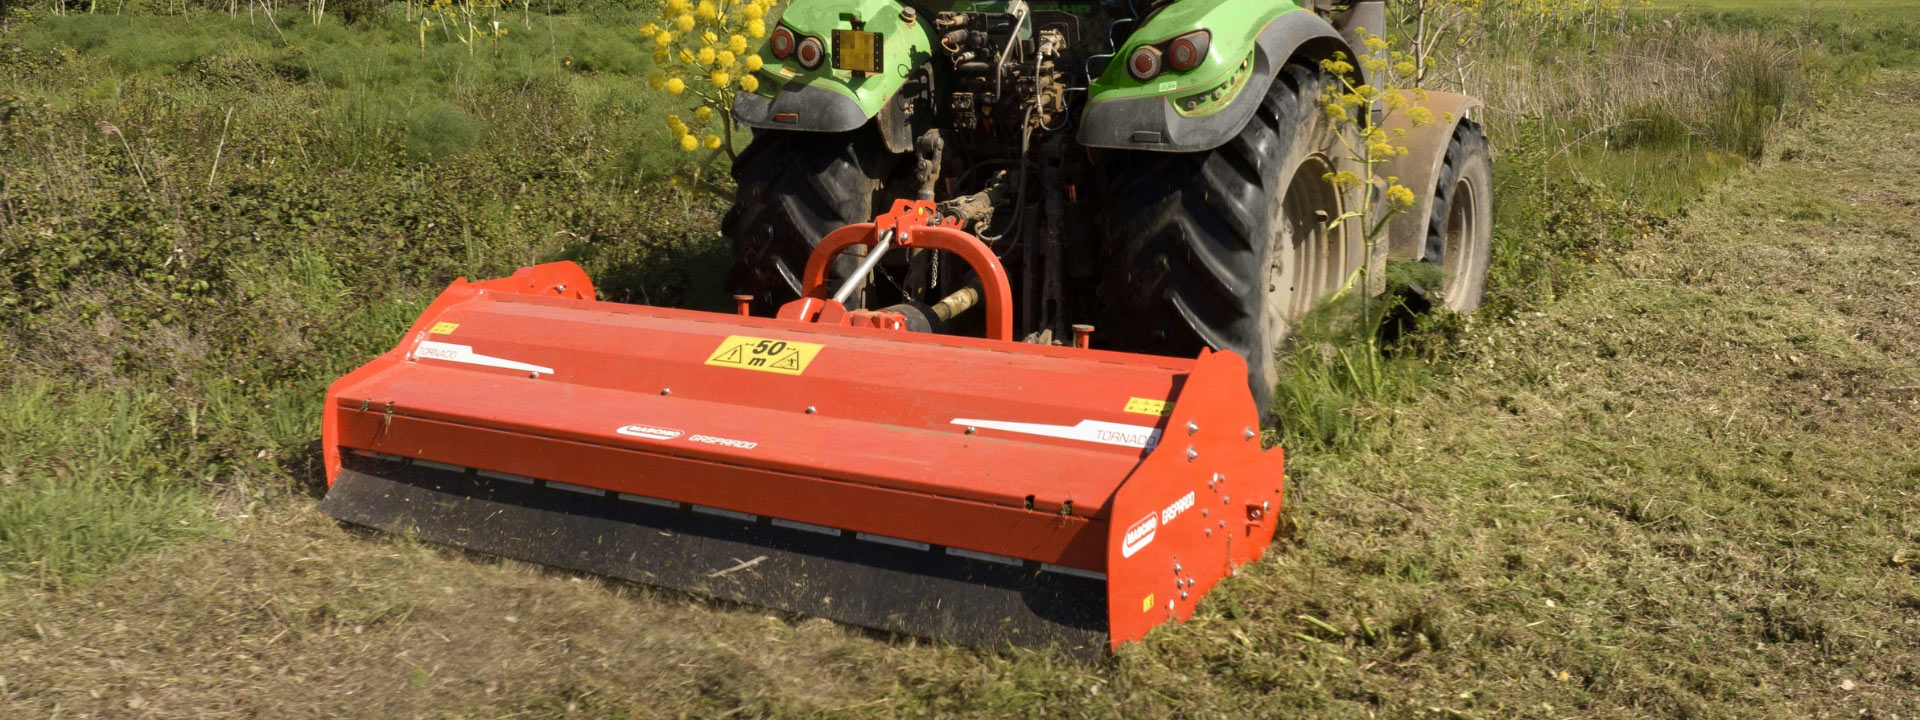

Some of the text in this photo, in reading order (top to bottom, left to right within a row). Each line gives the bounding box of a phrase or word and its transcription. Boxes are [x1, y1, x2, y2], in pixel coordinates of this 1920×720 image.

[752, 340, 787, 356] 50
[748, 357, 767, 367] m
[688, 434, 758, 449] GASPARDO
[1096, 429, 1157, 447] TORNADO
[1127, 490, 1195, 546] MASCHIO GASPARDO
